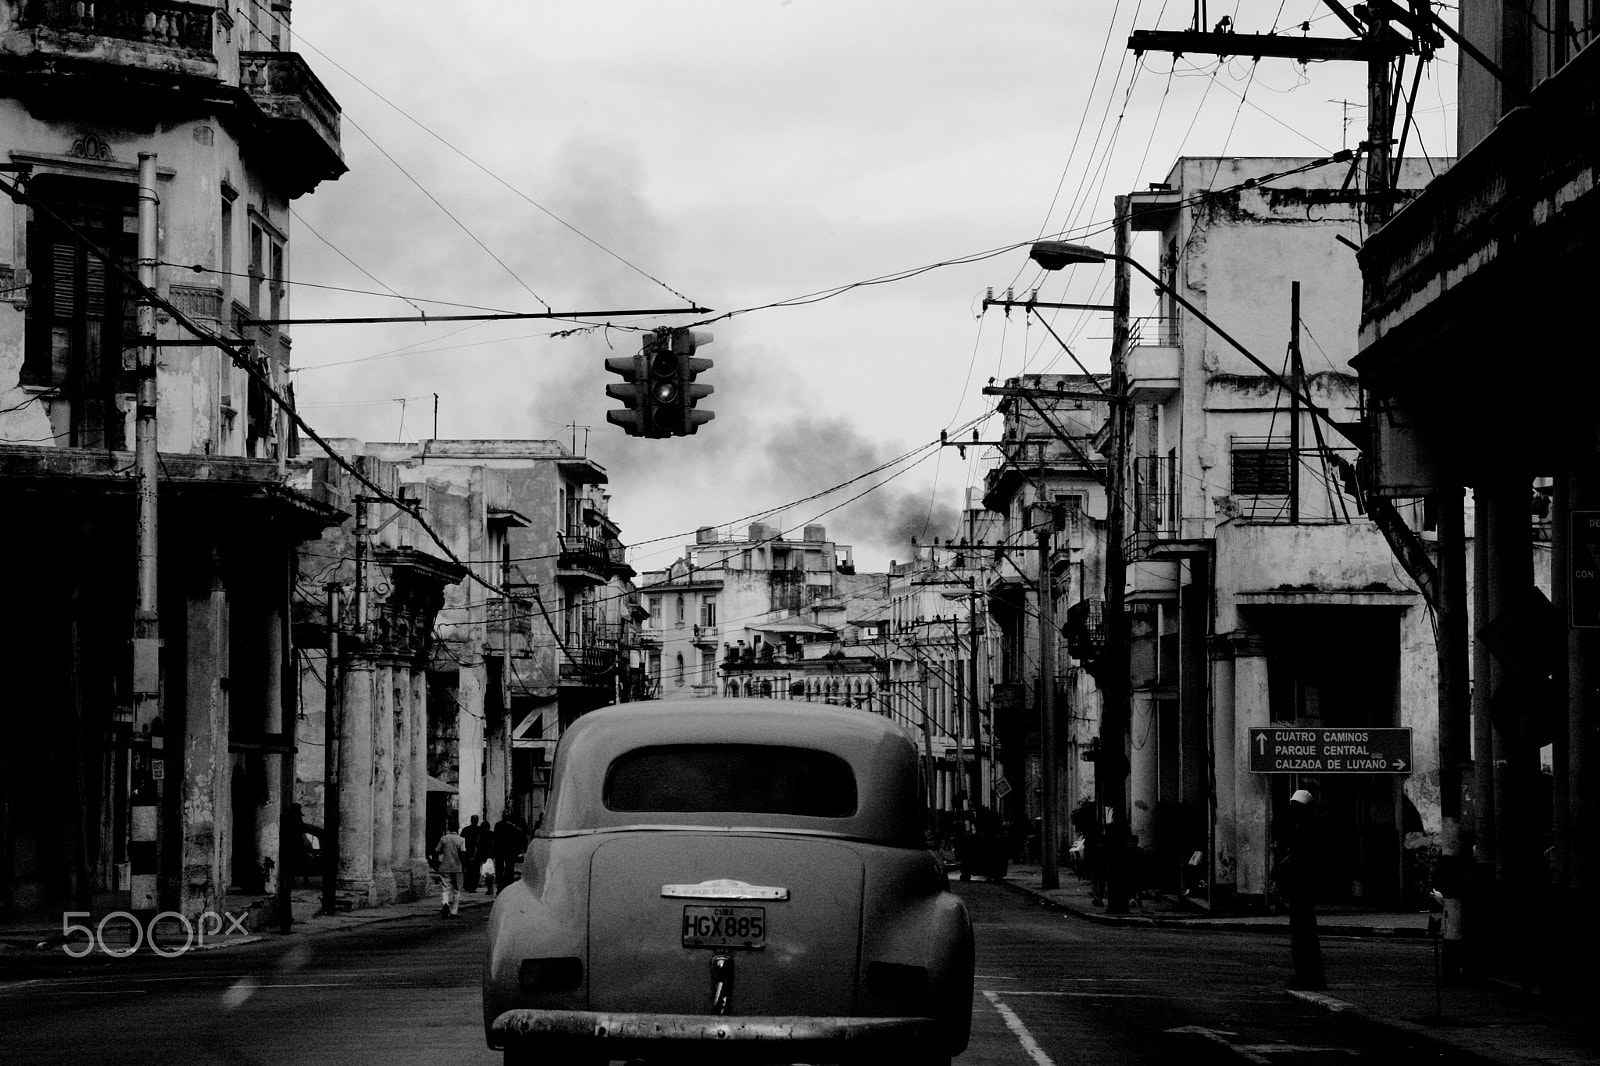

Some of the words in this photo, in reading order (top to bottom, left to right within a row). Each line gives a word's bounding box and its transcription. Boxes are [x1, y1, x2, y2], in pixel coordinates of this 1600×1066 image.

[1575, 570, 1594, 579] CON
[1275, 732, 1316, 742] CUATRO
[1323, 732, 1369, 742] CAMINOS
[1275, 746, 1316, 756] PARQUE
[1323, 746, 1369, 755] CENTRAL
[1275, 759, 1322, 769] CALZADA
[1328, 759, 1341, 769] DE
[684, 915, 763, 938] HGX885
